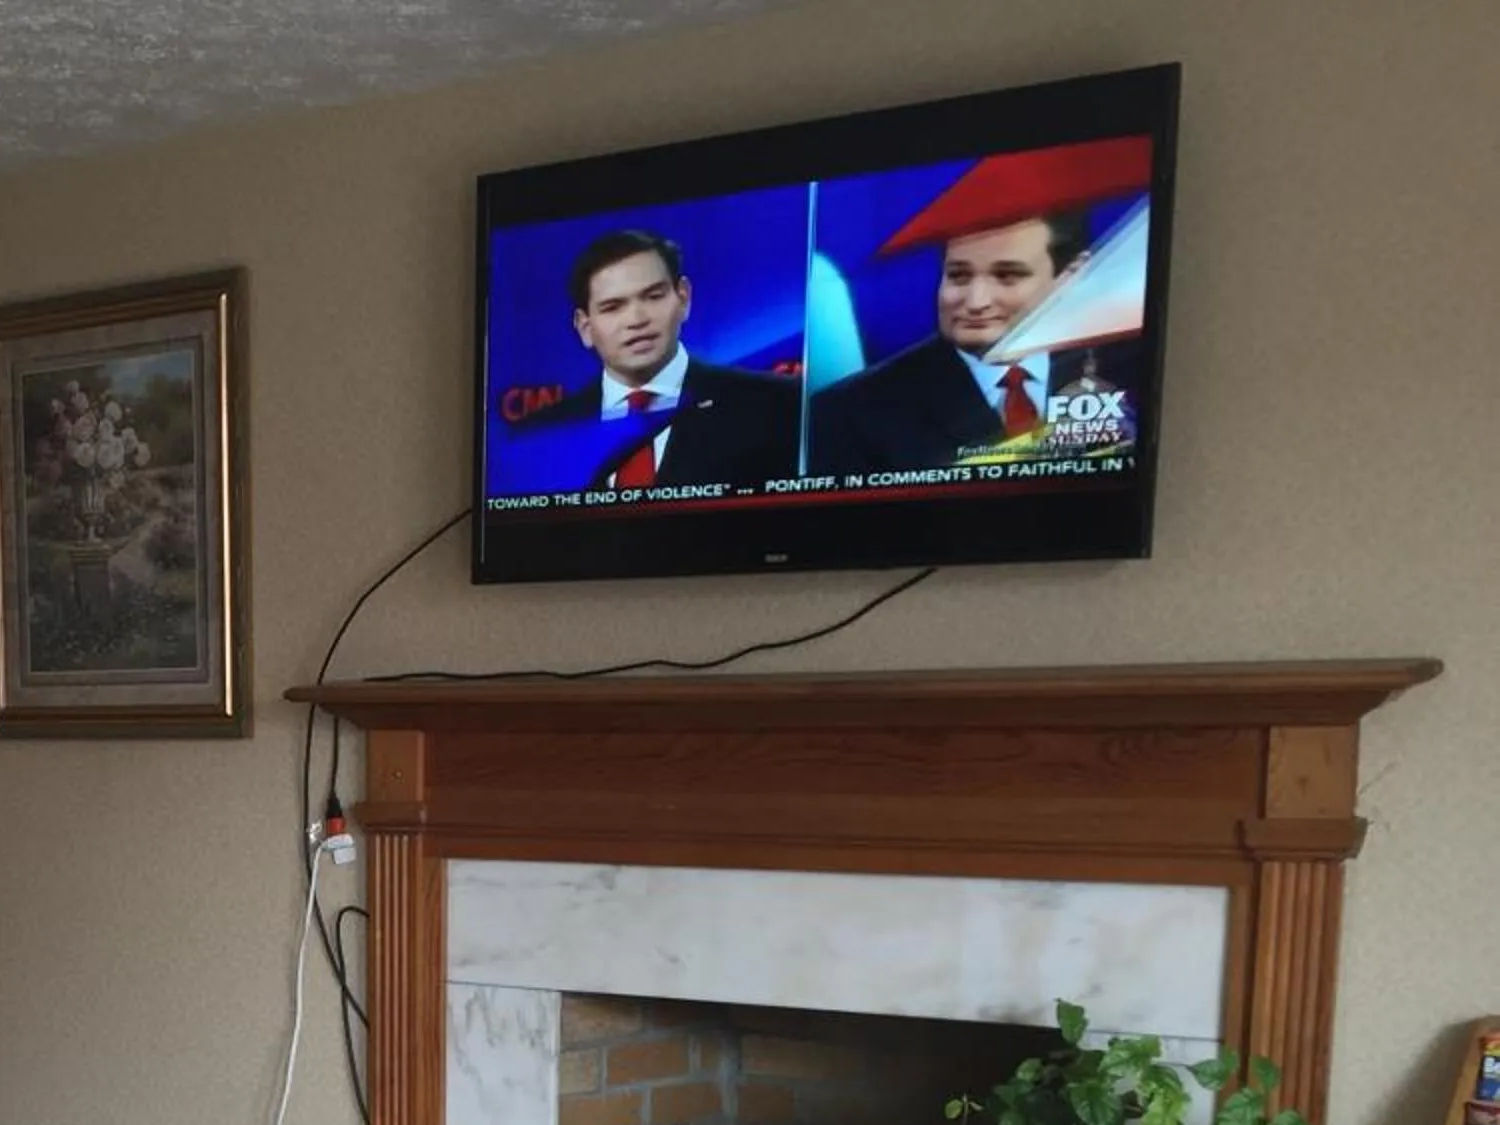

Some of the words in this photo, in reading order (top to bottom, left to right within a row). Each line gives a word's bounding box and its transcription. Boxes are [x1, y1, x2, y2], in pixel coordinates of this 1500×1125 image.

[1047, 391, 1125, 423] FOX
[1055, 420, 1118, 435] NEWS
[487, 496, 549, 510] TOWARD
[554, 494, 582, 507] THE
[585, 490, 617, 504] END
[621, 488, 643, 502] OF
[765, 476, 840, 492] PONTIFF,
[845, 475, 863, 488] IN
[867, 467, 971, 486] COMMENTS
[978, 465, 1003, 479] TO
[1008, 460, 1097, 477] FAITHFUL
[1102, 457, 1123, 471] IN
